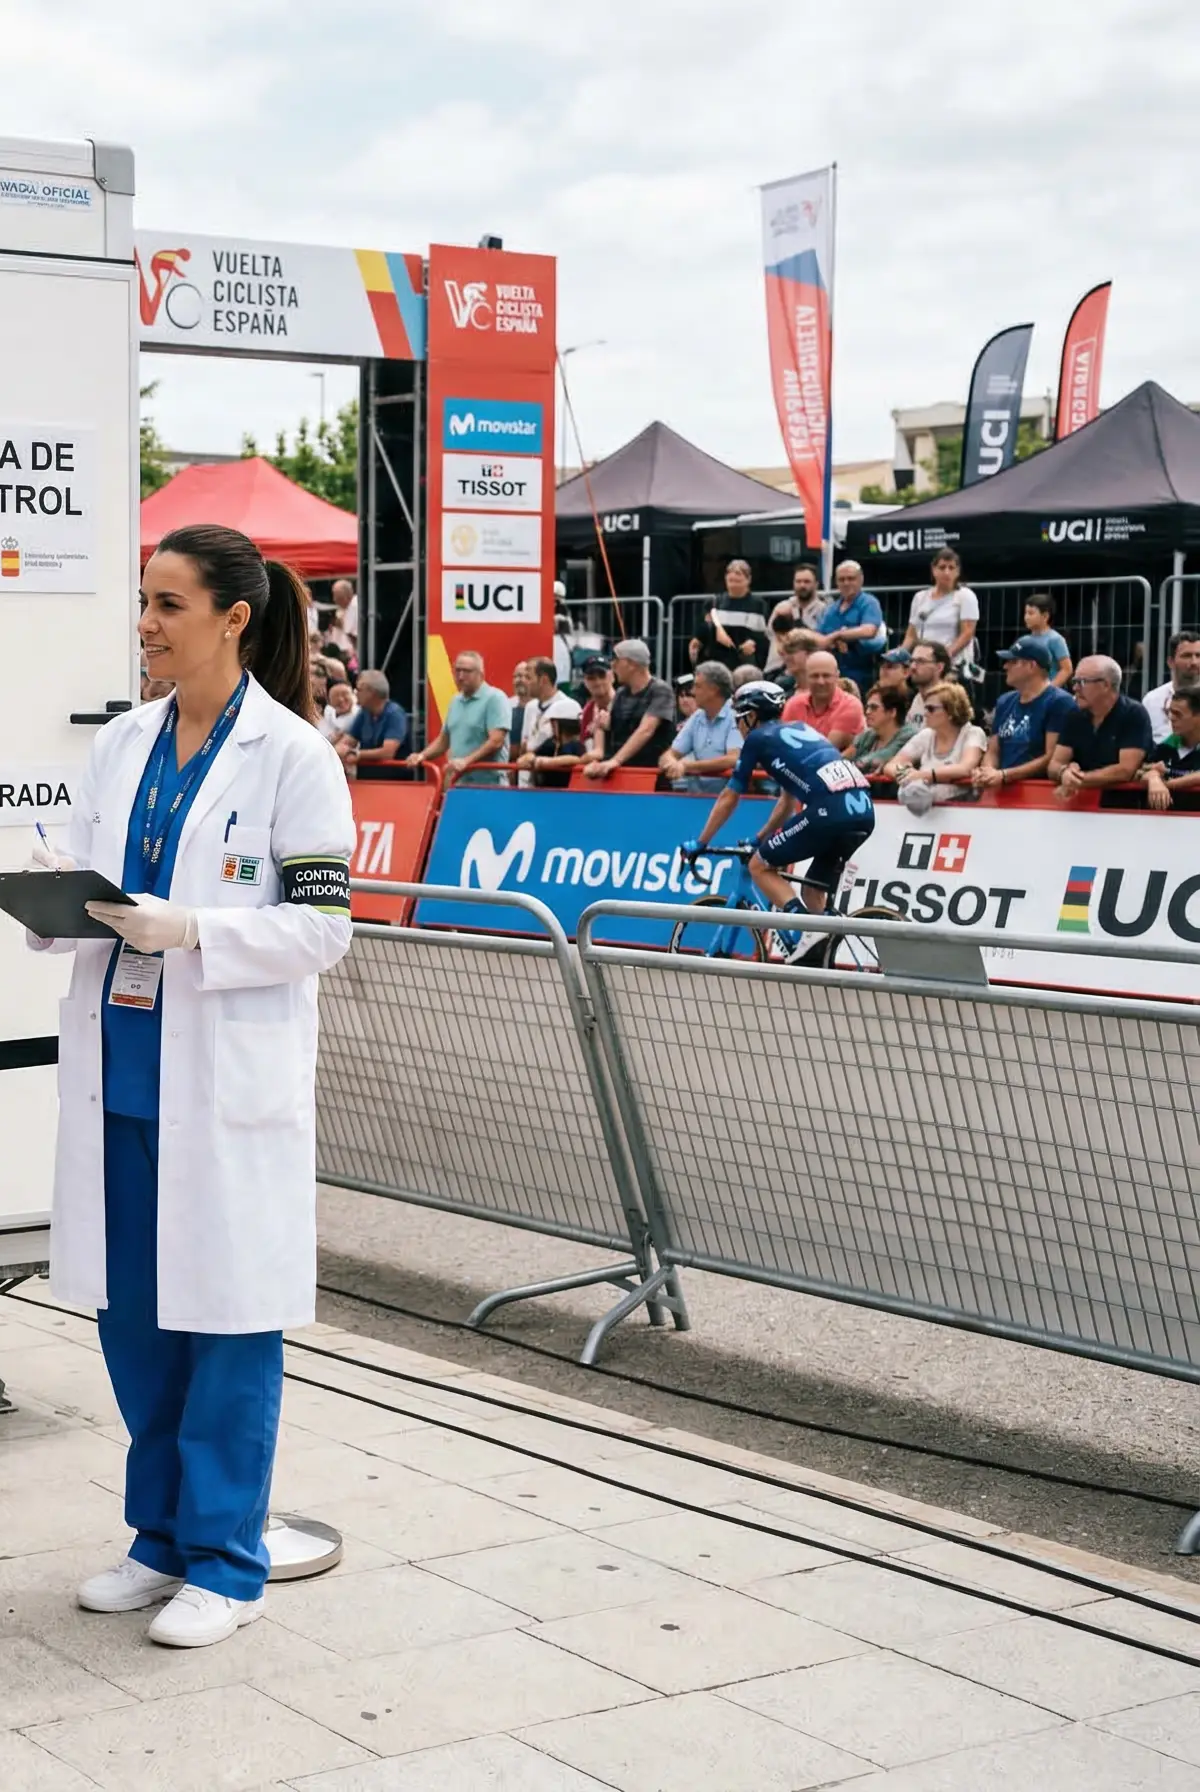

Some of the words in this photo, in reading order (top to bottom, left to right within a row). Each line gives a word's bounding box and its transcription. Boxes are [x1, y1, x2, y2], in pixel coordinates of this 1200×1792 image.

[42, 186, 91, 200] OFICIAL
[212, 250, 283, 278] VUELTA
[213, 280, 299, 308] CICLISTA
[213, 308, 288, 336] ESPAÑA
[31, 441, 75, 472] DE
[977, 410, 1012, 475] UCI
[457, 479, 528, 497] TISSOT
[603, 514, 640, 532] UCI
[1049, 518, 1093, 543] UCI
[877, 530, 916, 553] UCI
[467, 584, 525, 612] UCI
